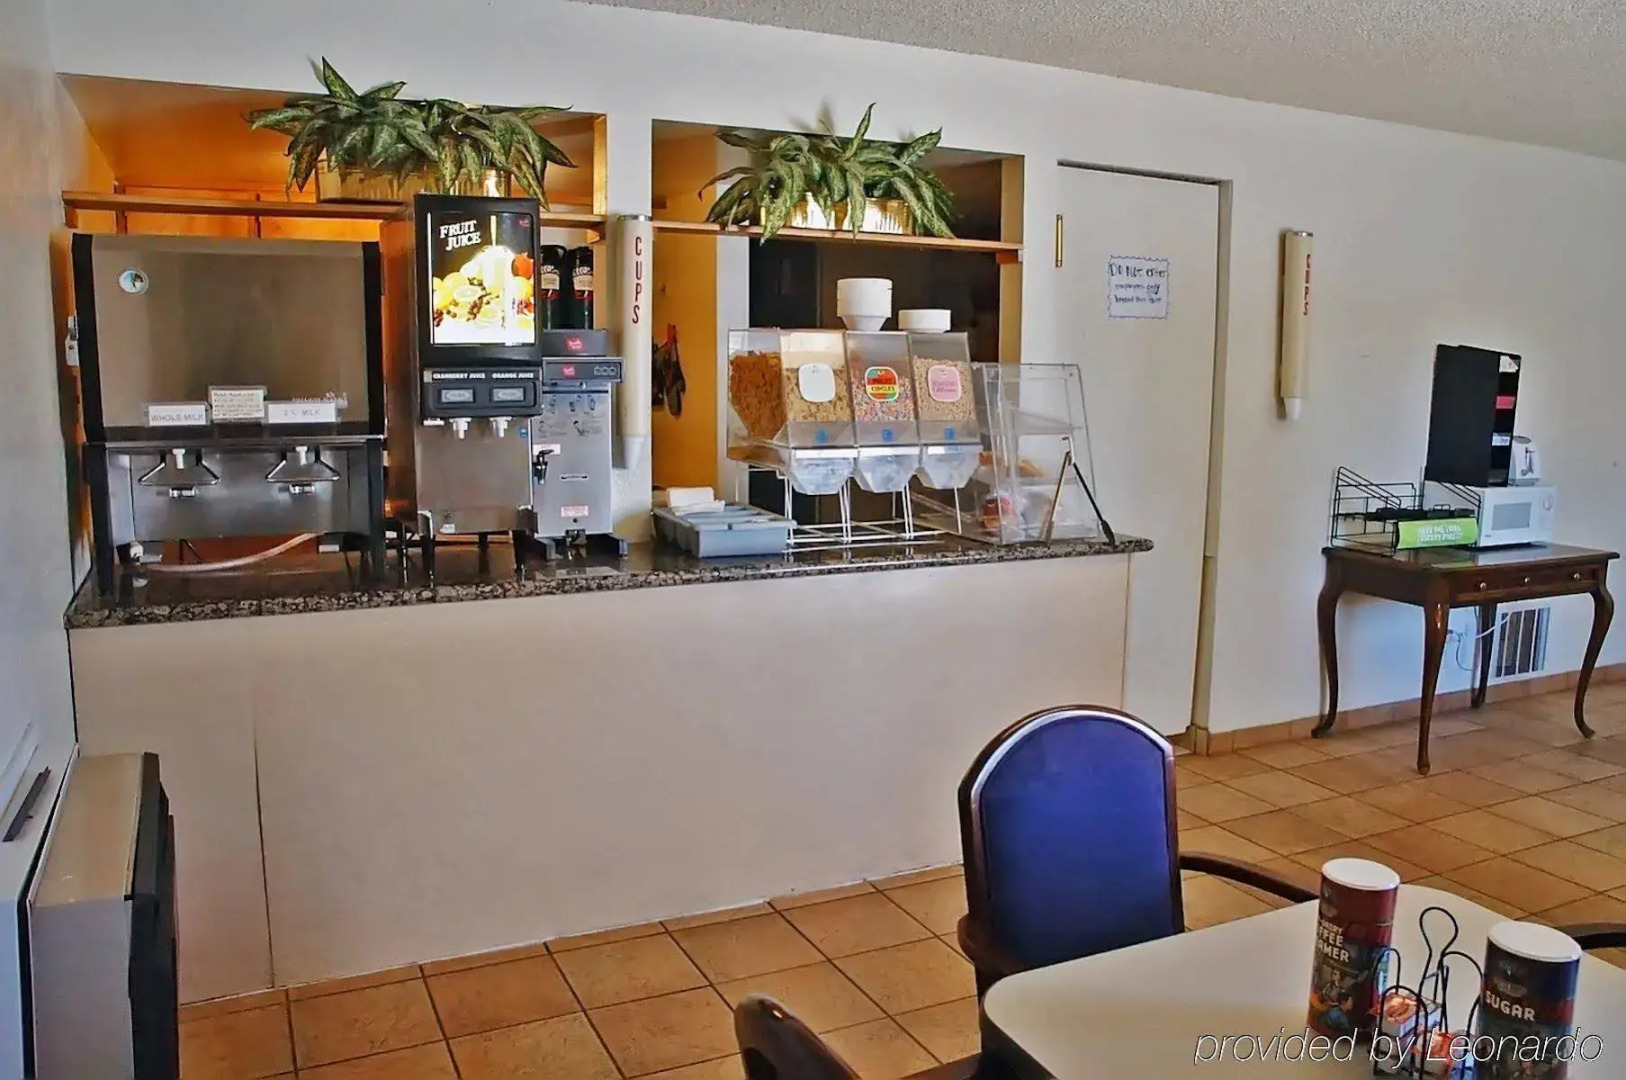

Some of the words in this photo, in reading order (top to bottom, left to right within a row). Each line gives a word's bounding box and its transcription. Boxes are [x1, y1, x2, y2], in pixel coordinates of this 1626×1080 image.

[440, 220, 477, 239] FRUIT
[445, 231, 482, 252] JUICE
[631, 236, 642, 324] CUPS
[1303, 253, 1311, 316] CUPS
[432, 372, 468, 380] CRANBERRY
[469, 372, 486, 380] JUICE
[150, 413, 181, 422] WHOLE
[183, 413, 205, 421] MILK
[1318, 925, 1344, 948] FFEE
[1316, 938, 1350, 963] AMER
[1484, 990, 1536, 1022] SUGAR
